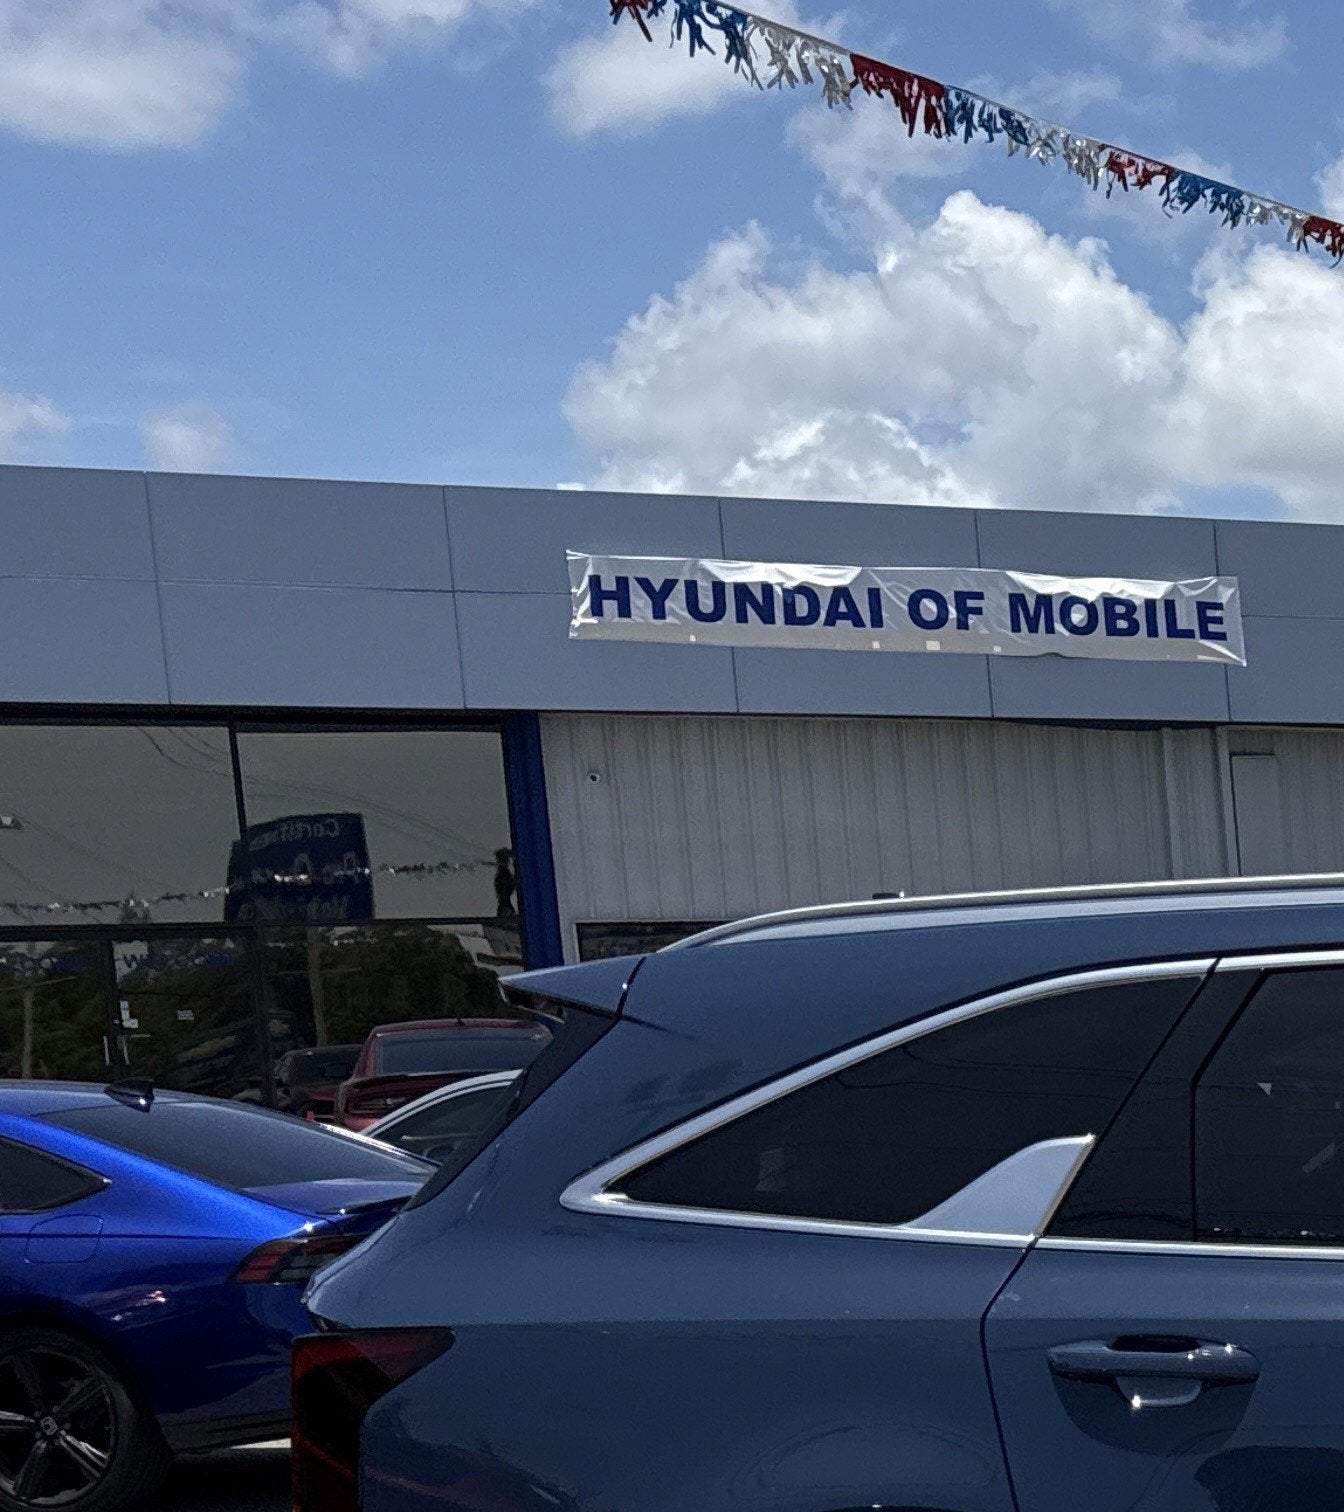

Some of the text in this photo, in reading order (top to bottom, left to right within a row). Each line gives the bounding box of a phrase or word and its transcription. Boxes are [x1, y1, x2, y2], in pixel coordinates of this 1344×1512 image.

[588, 575, 1229, 642] HYUNDAI OF MOBILE
